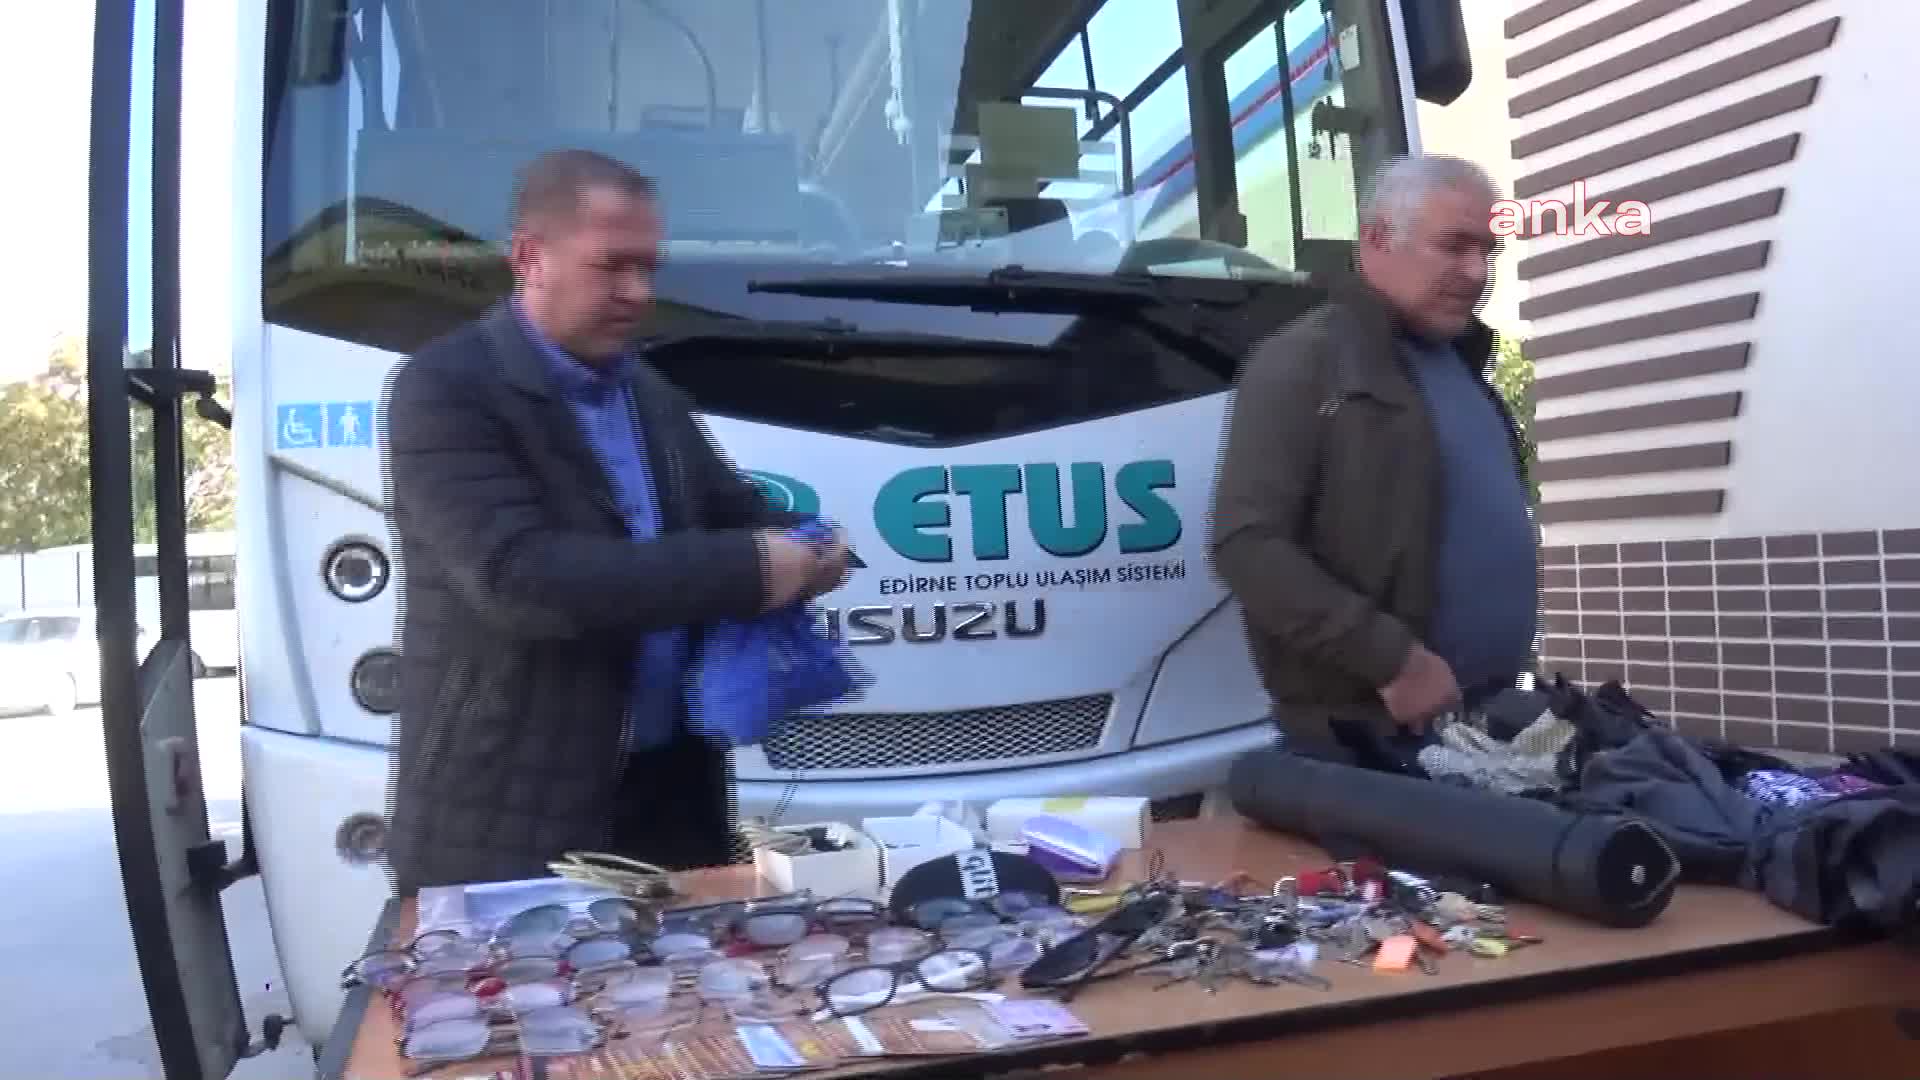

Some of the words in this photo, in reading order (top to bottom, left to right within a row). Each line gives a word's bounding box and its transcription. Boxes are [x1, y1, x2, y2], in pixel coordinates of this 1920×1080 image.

[873, 459, 1183, 563] ETUS
[879, 573, 957, 595] EDİRNE
[964, 571, 1029, 591] TOPLU
[1035, 567, 1111, 590] ULAŞIM
[1116, 559, 1185, 583] SİSTEMİ
[826, 598, 1046, 645] ISUZU
